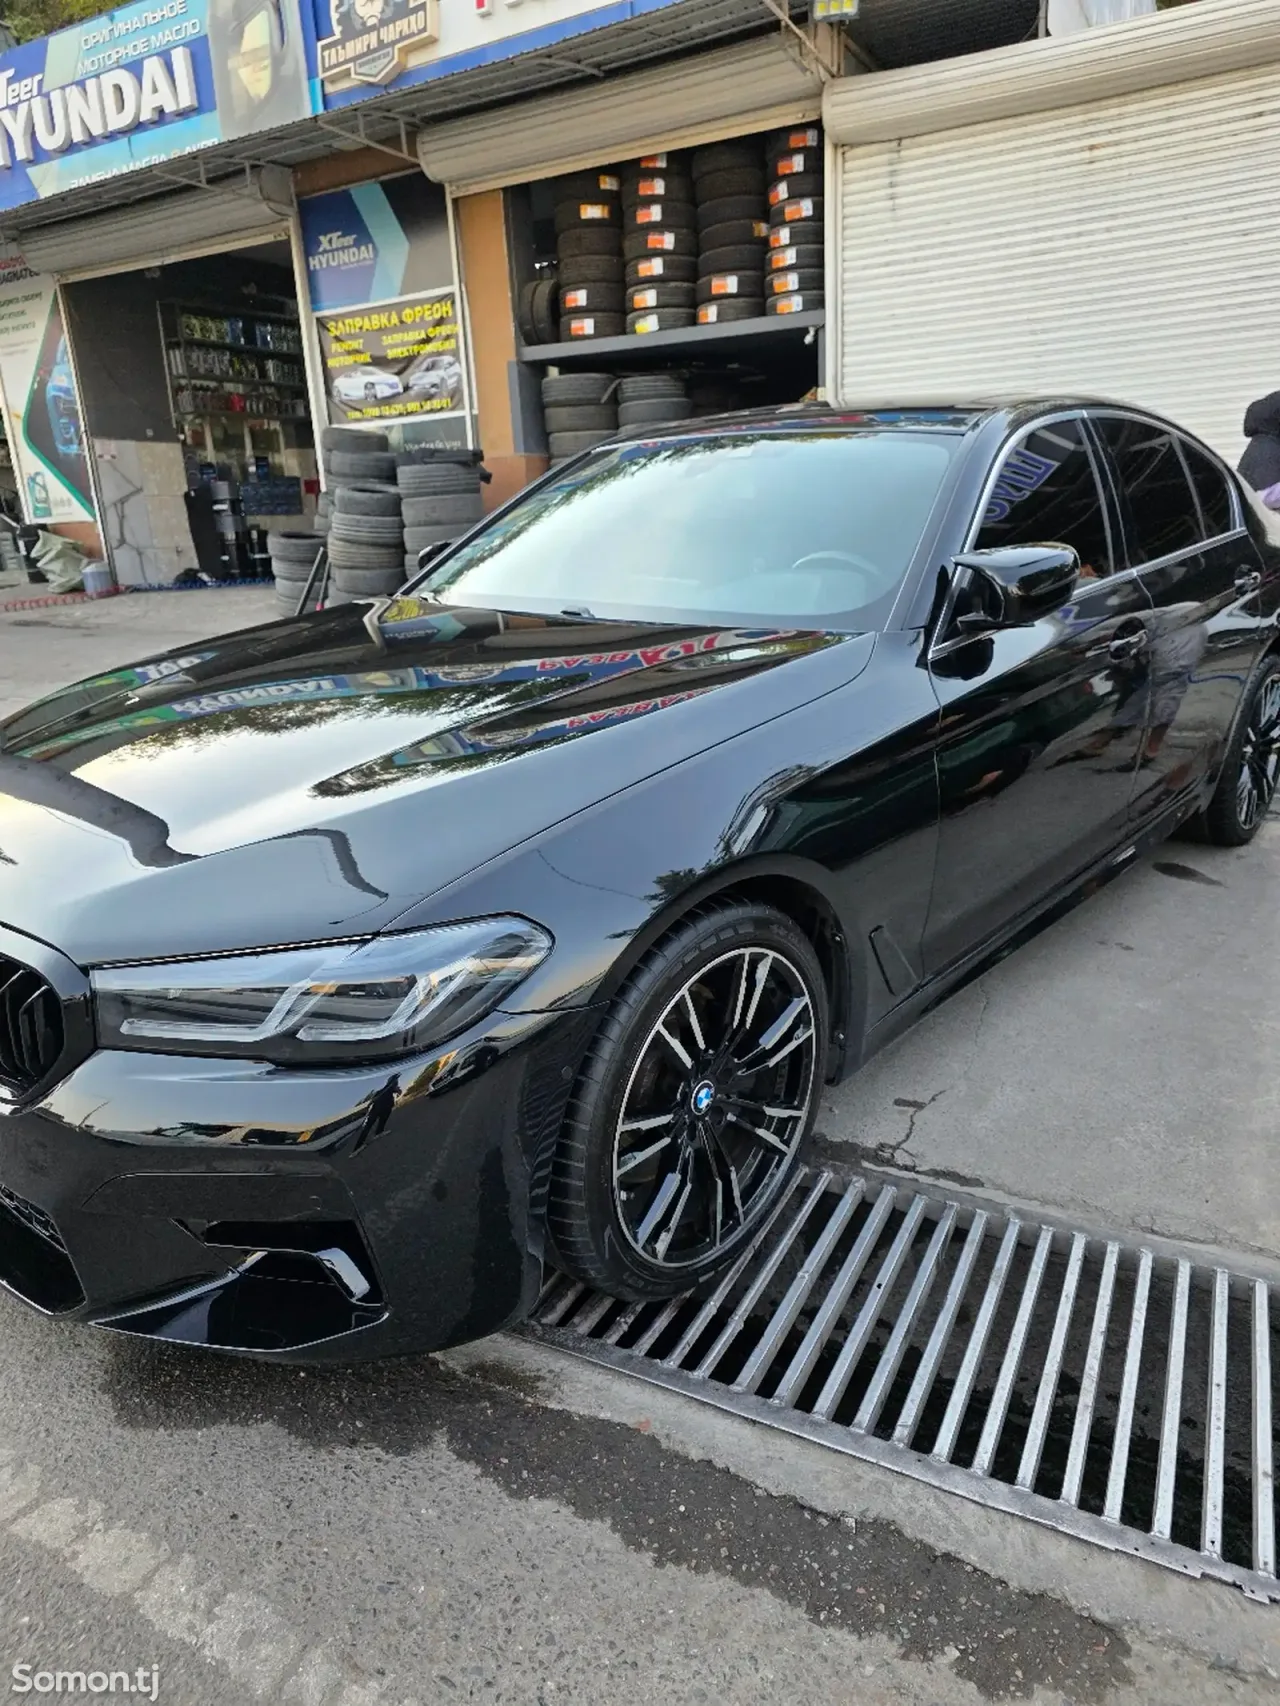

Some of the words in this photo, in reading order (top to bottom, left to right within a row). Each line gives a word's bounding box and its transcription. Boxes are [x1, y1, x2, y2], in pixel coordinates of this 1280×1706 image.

[78, 41, 149, 76] МОТОРНОЕ
[152, 19, 200, 50] МАСЛО
[82, 0, 188, 51] ОРИГИНАЛЬНОЕ
[309, 243, 373, 270] HYUNDAI
[327, 311, 399, 337] ЗАПРАВКА
[402, 300, 452, 323] ФРЕОН
